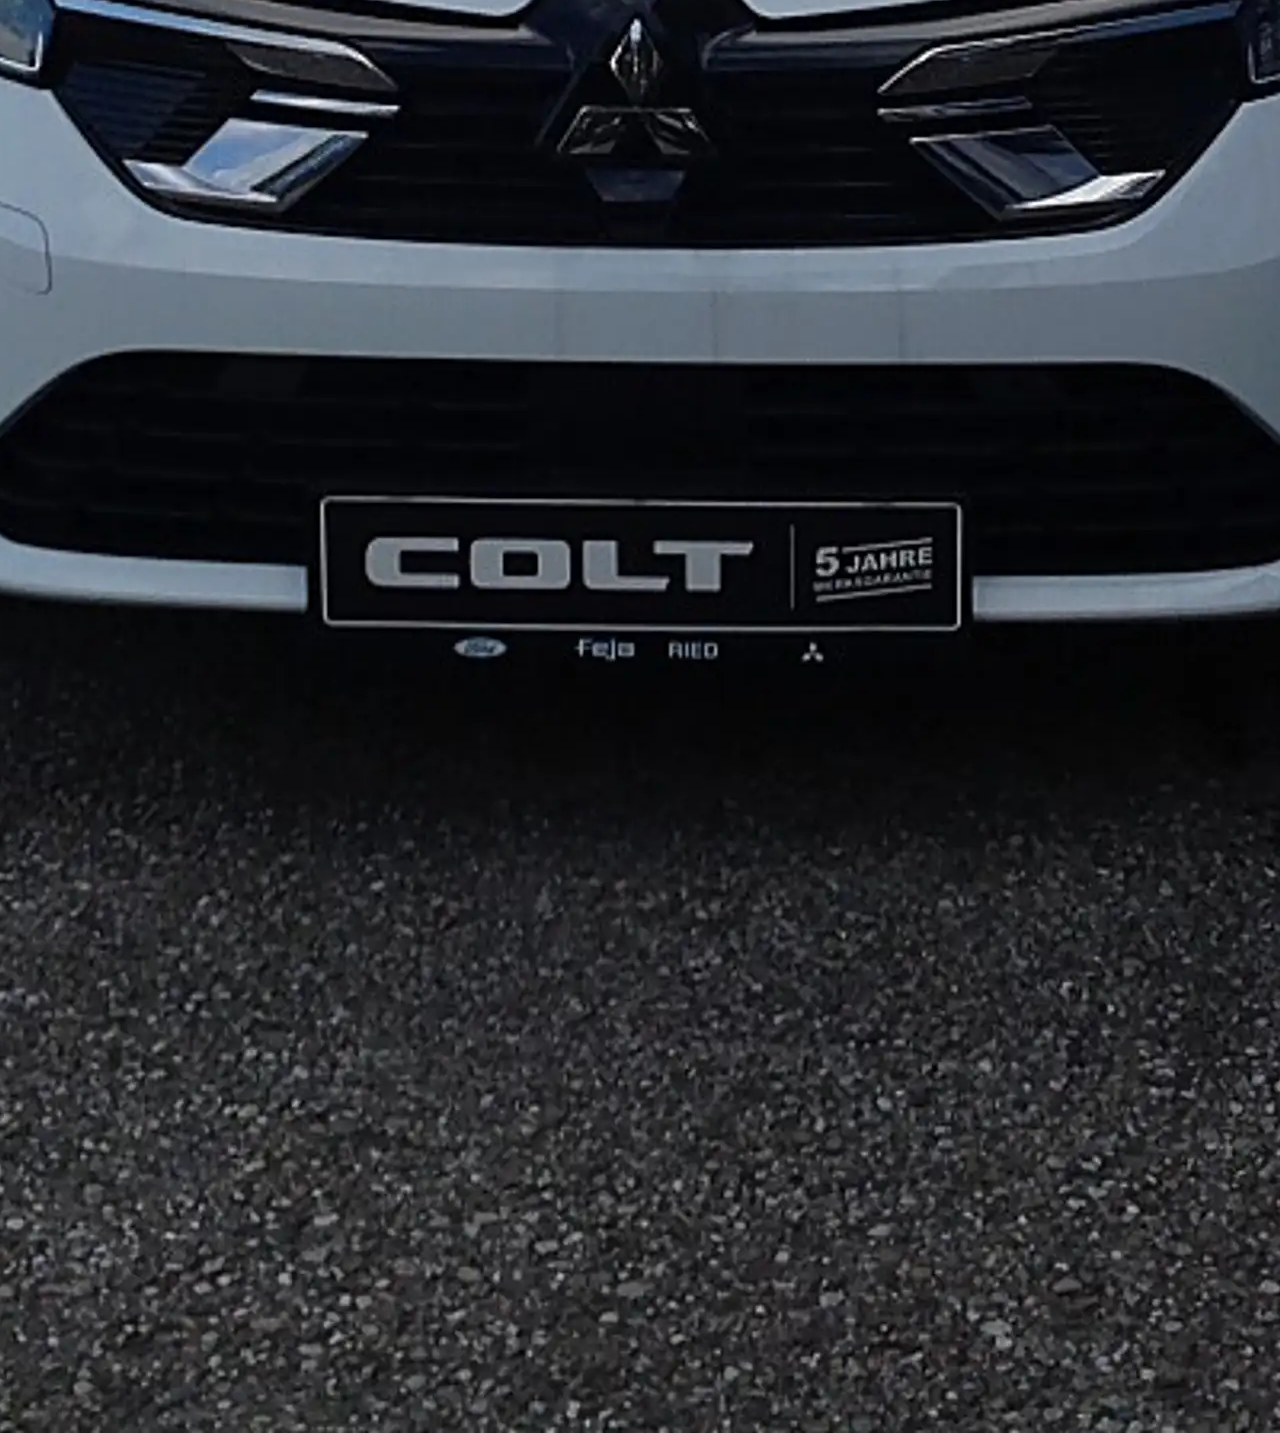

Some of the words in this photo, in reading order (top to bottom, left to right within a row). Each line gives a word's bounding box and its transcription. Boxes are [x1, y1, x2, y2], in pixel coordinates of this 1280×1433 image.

[365, 537, 754, 592] COLT
[815, 546, 840, 577] 5
[845, 546, 933, 574] JAHRE
[575, 637, 636, 662] Feja
[668, 641, 719, 660] RIED
